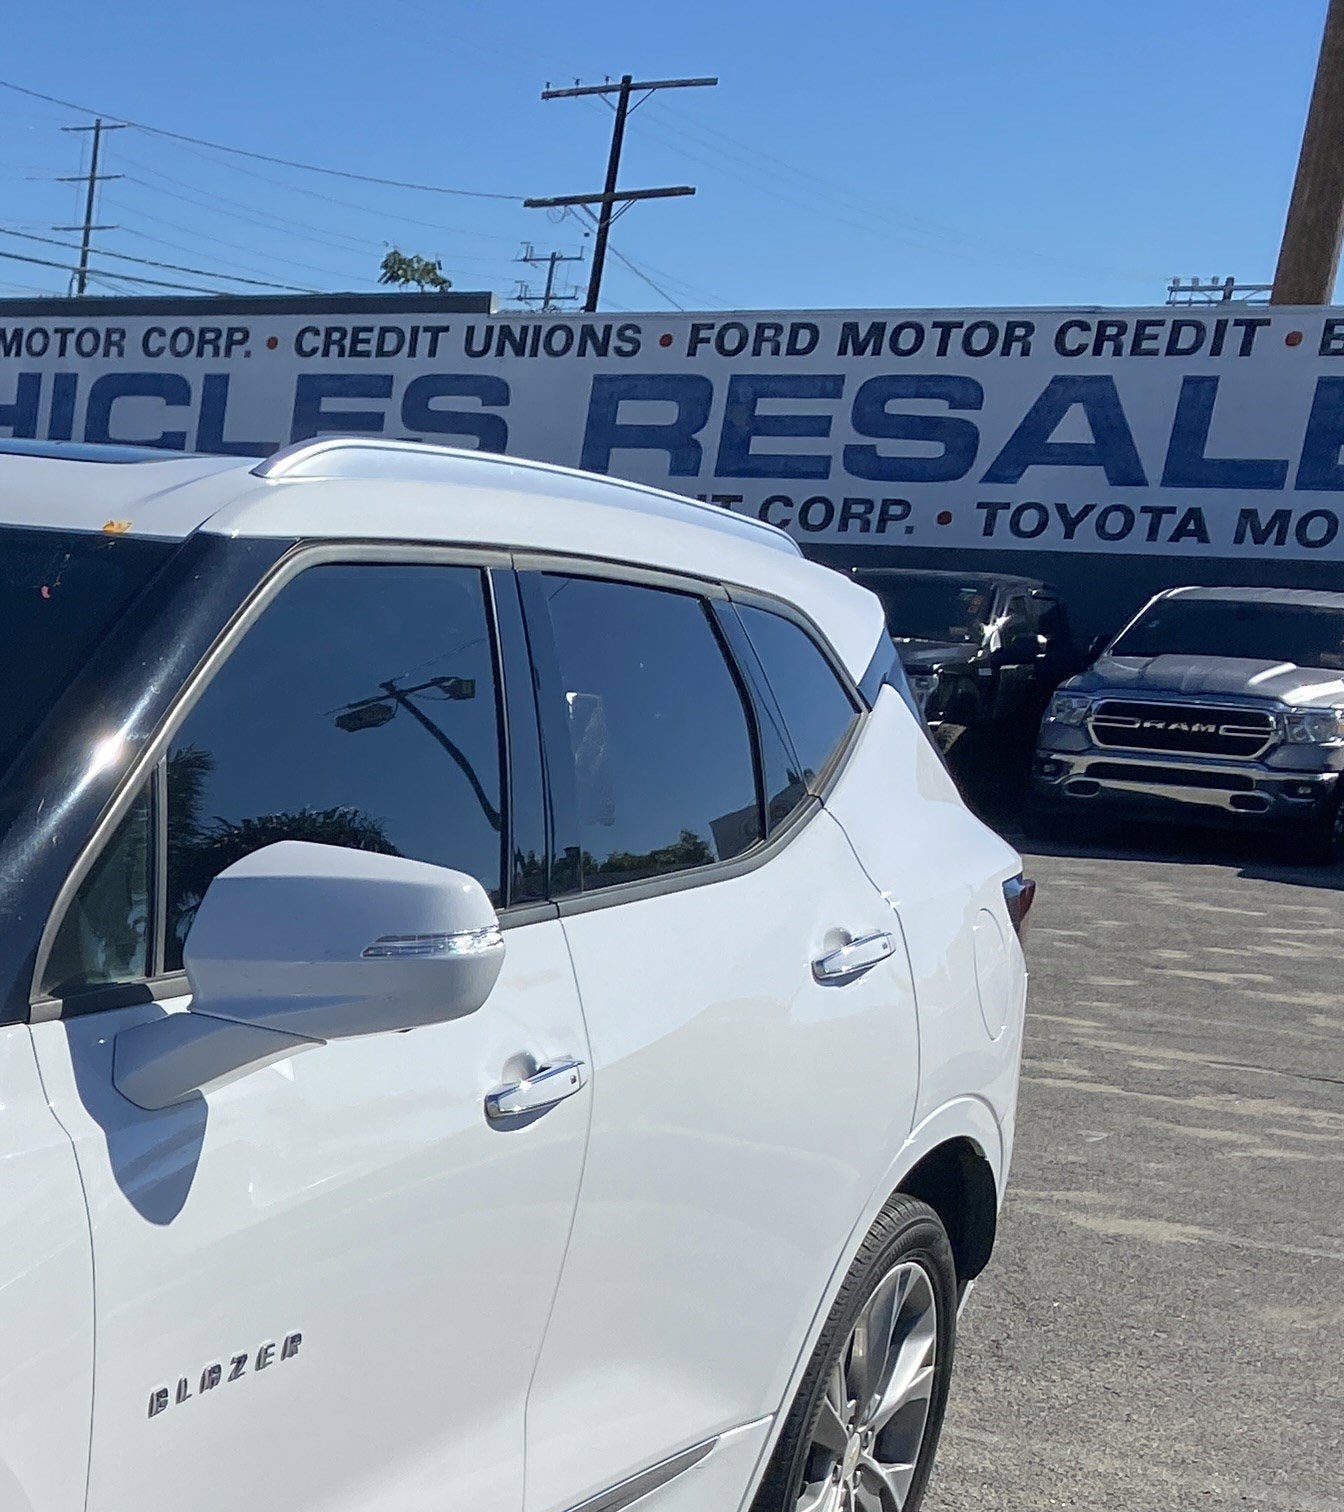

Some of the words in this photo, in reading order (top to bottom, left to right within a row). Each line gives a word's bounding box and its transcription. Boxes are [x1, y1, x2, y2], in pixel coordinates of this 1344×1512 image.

[141, 325, 251, 358] CORP.
[294, 324, 450, 358] CREDIT
[463, 323, 642, 358] UNIONS
[686, 321, 820, 357] FORD
[836, 320, 1036, 357] MOTOR
[1054, 318, 1271, 357] CREDIT
[758, 494, 914, 534] CORP.
[976, 502, 1211, 544] TOYOTA
[1232, 508, 1340, 549] MO
[1143, 720, 1216, 733] RAM
[146, 1330, 303, 1420] BLAZER
